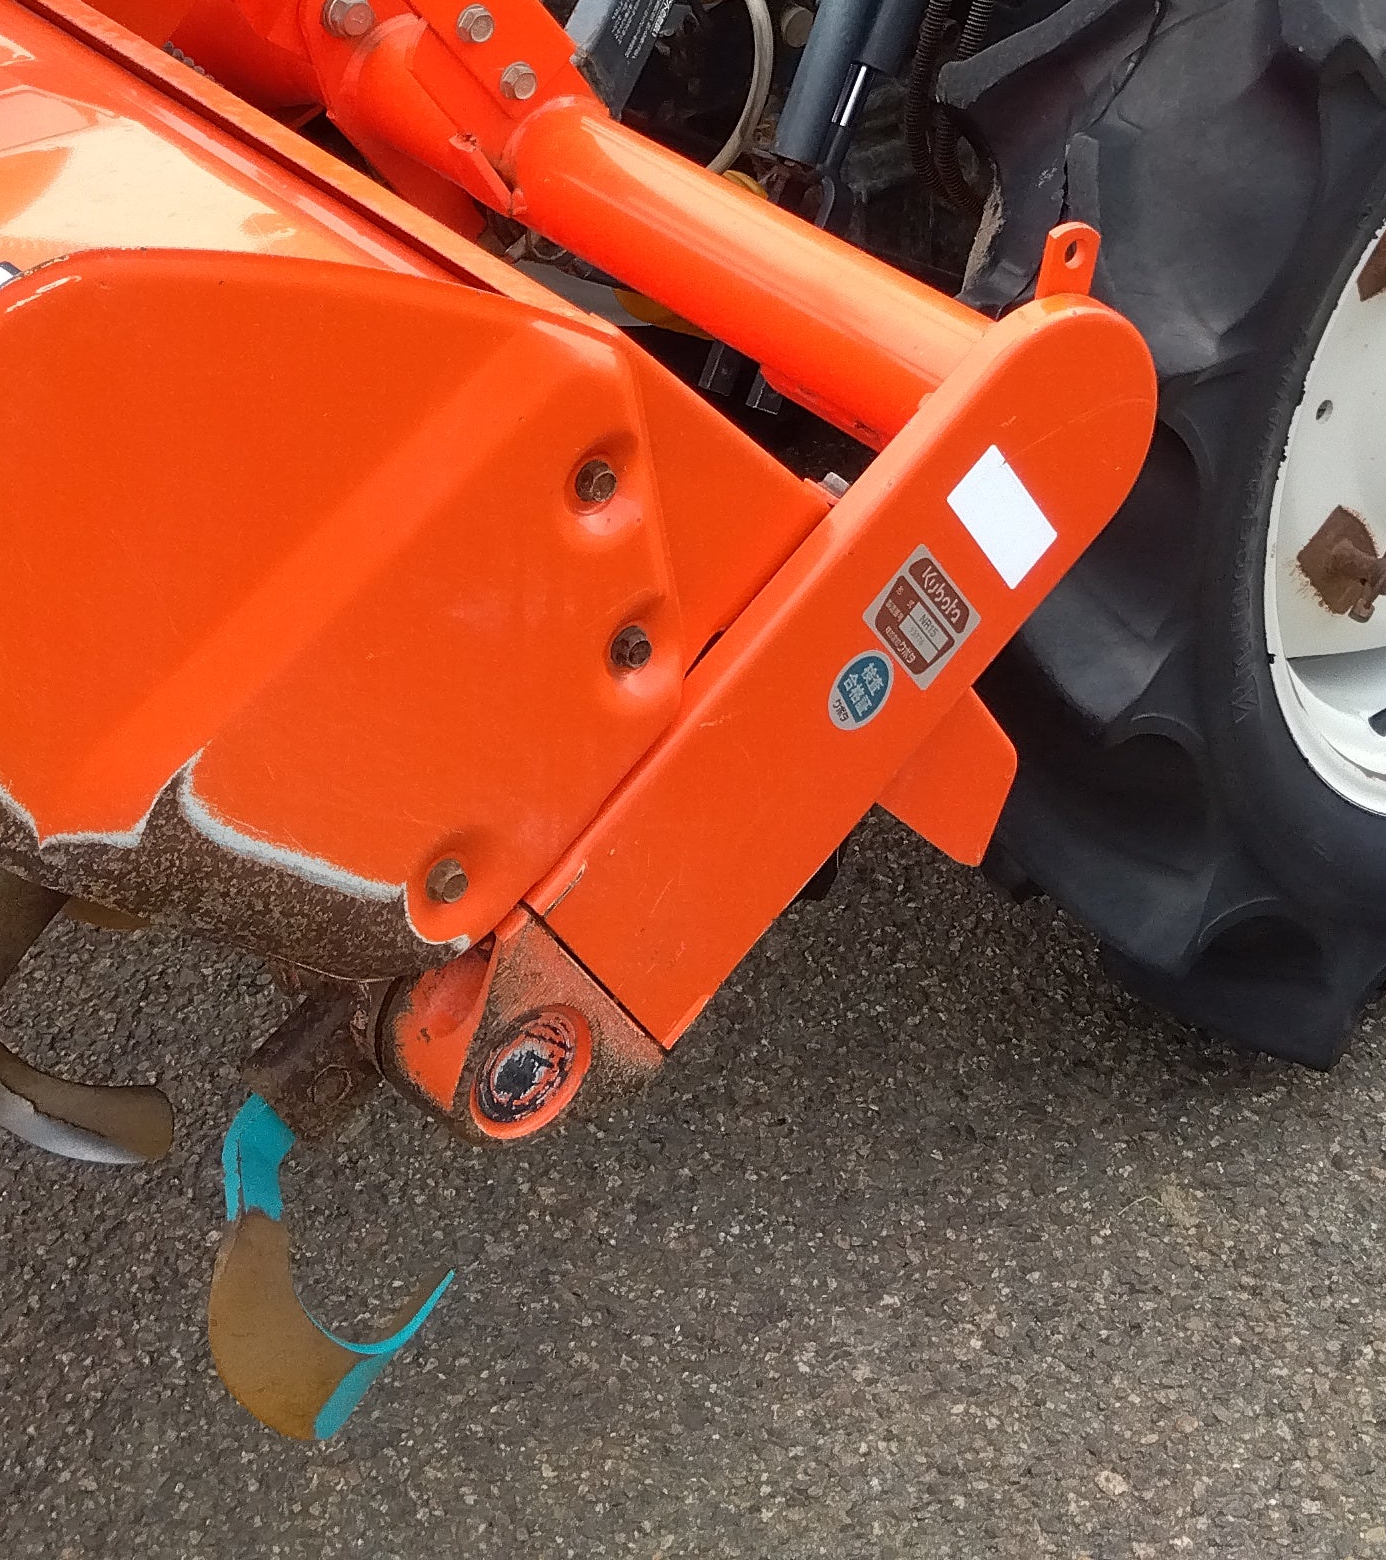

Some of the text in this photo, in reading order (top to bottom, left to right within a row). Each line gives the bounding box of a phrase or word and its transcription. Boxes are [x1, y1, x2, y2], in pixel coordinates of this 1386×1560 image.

[921, 565, 961, 624] Kubota
[918, 614, 939, 638] NR15
[843, 673, 872, 717] 合格証
[861, 662, 884, 696] 検査
[833, 698, 850, 722] クボタ
